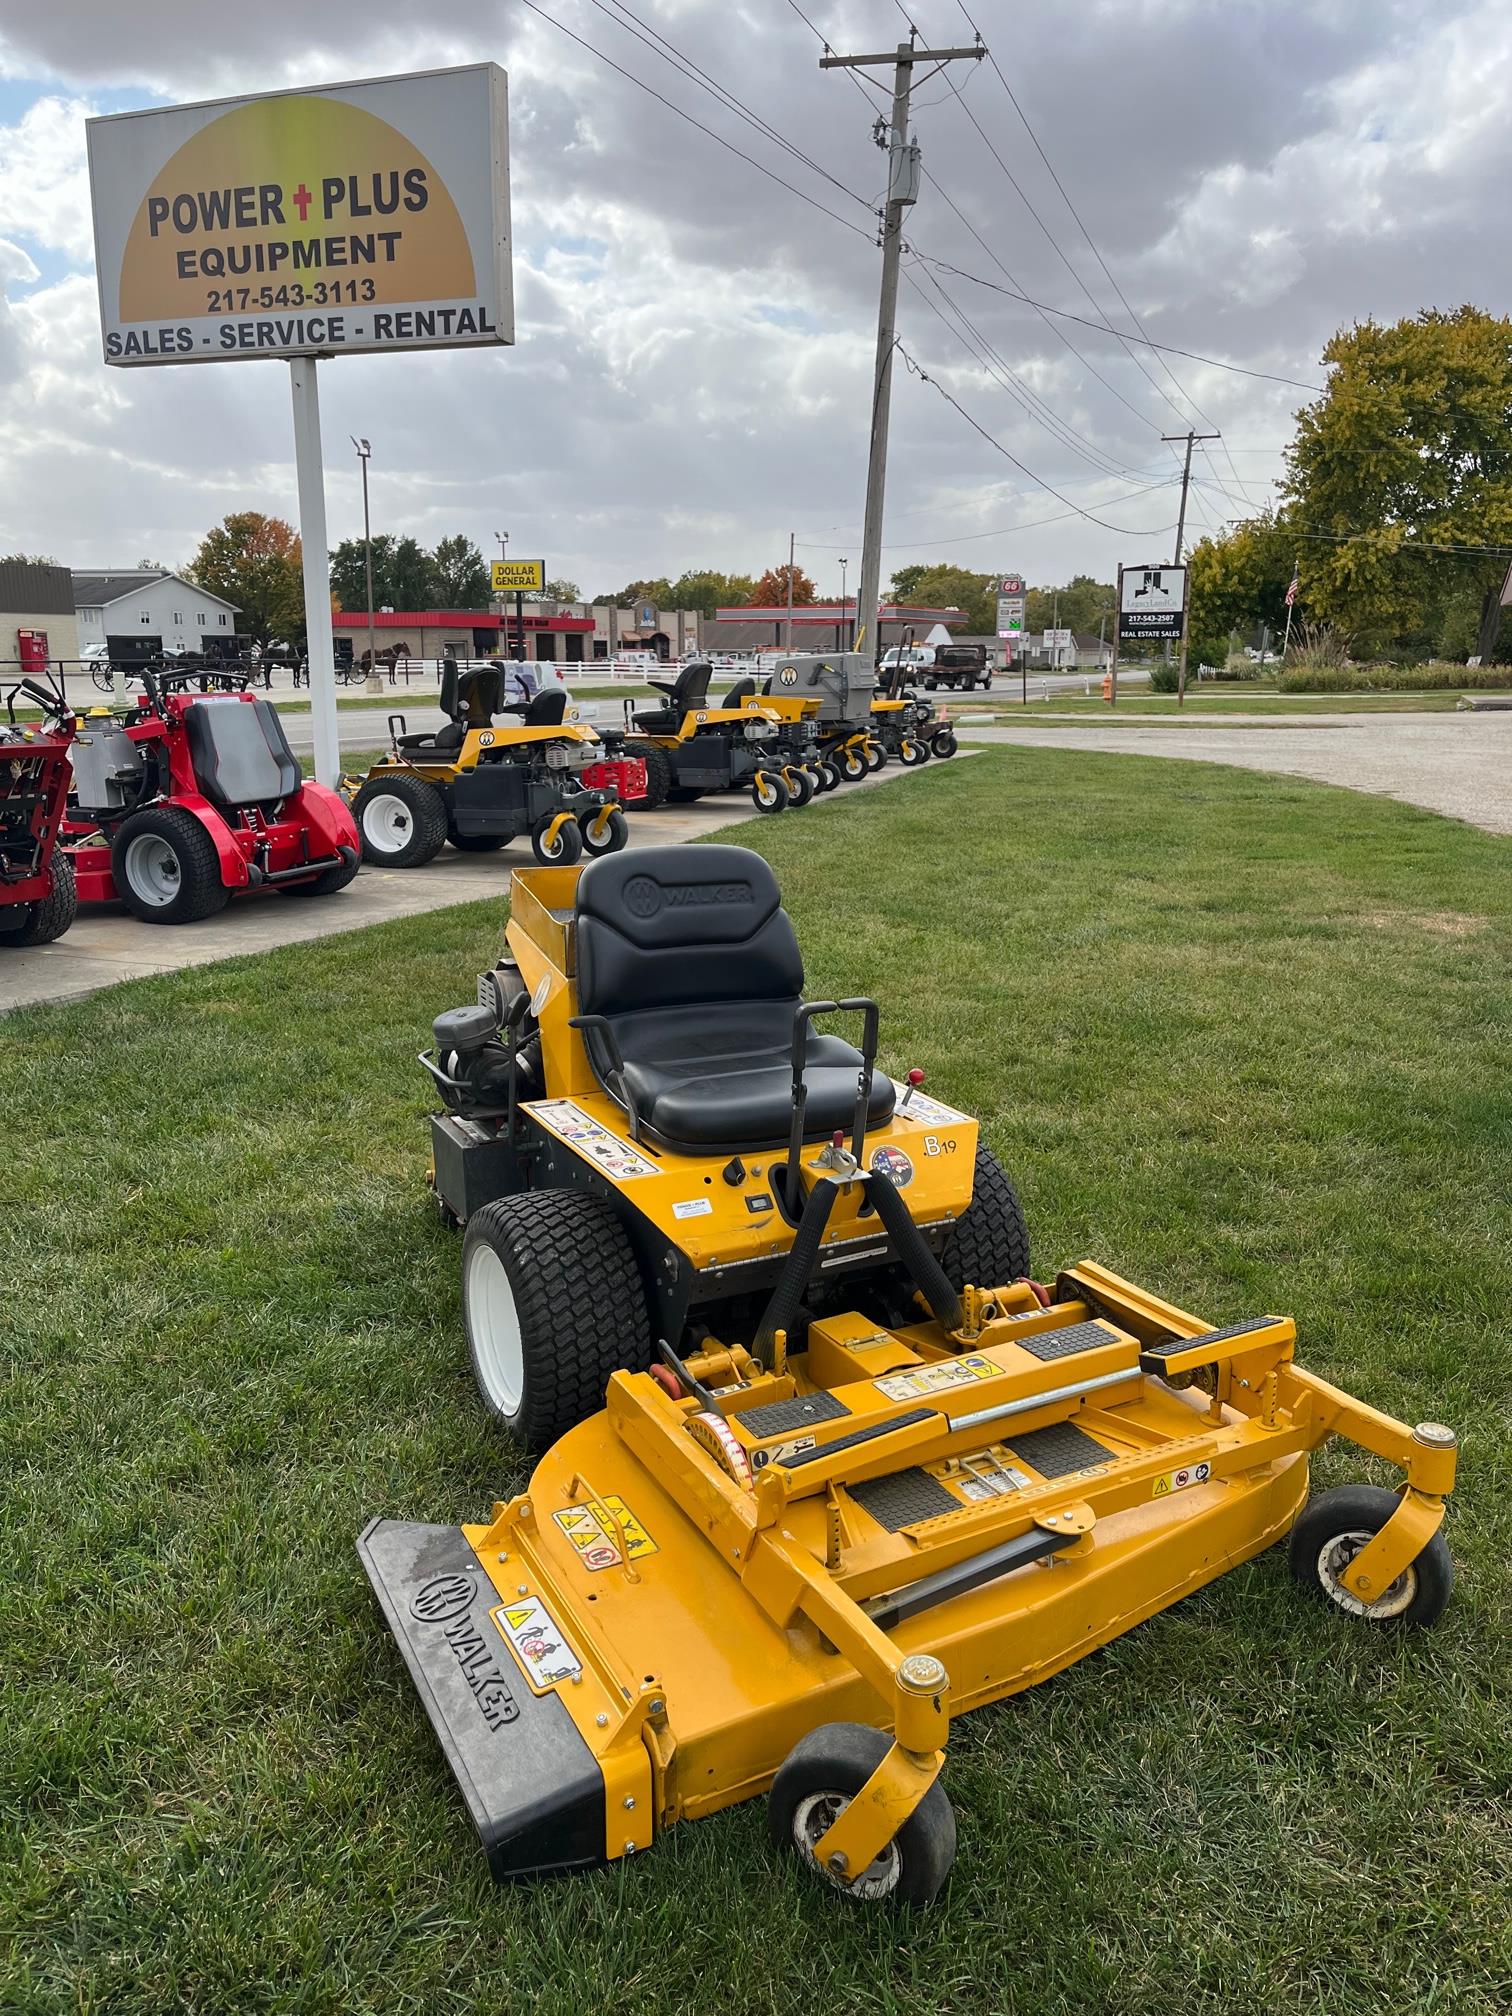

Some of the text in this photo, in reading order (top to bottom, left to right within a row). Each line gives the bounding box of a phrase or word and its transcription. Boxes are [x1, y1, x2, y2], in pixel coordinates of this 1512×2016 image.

[148, 168, 428, 236] POWER PLUS
[177, 231, 402, 278] EQUIPMENT
[207, 278, 376, 312] 217-543-3113
[107, 327, 193, 356] SALES
[220, 316, 345, 348] SERVICE
[374, 307, 496, 339] RENTAL
[495, 577, 537, 586] GENERAL
[498, 567, 535, 576] DOLLAR
[1004, 581, 1018, 590] 66
[663, 886, 754, 906] WALKER
[444, 1611, 520, 1733] WALKER
